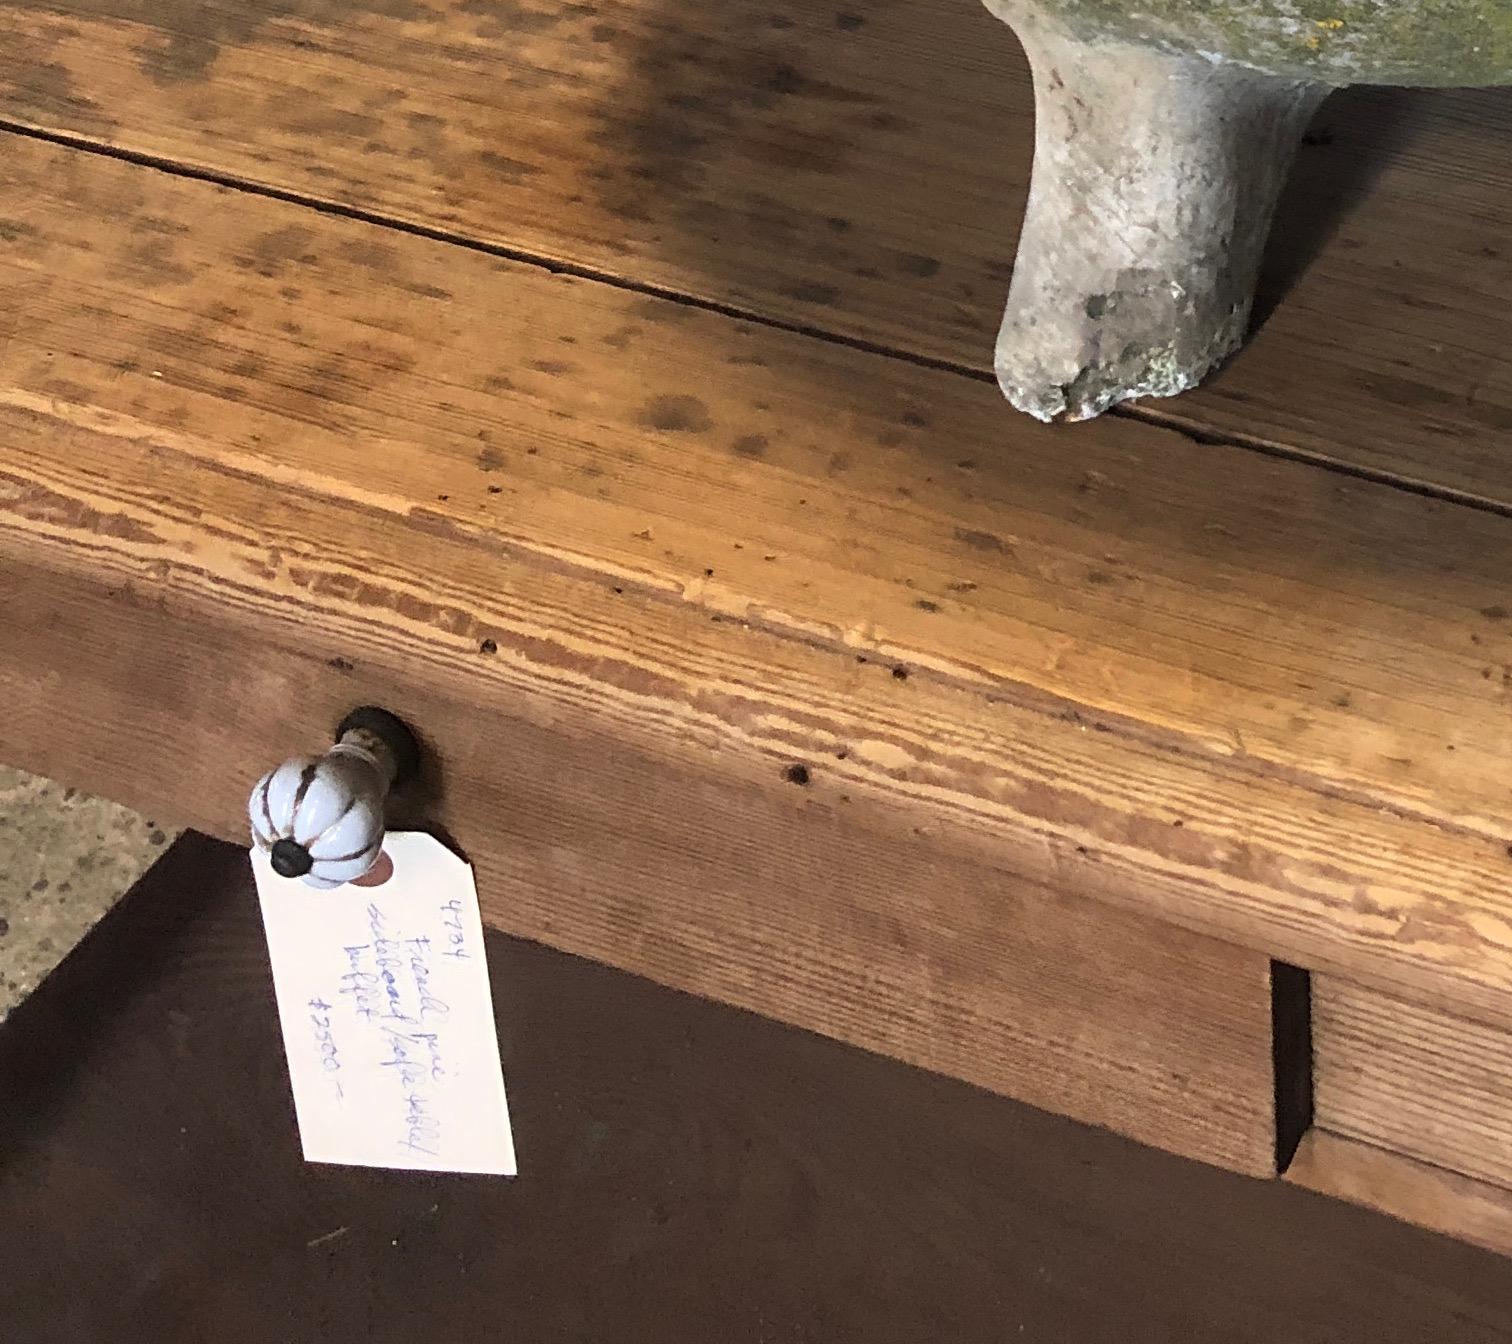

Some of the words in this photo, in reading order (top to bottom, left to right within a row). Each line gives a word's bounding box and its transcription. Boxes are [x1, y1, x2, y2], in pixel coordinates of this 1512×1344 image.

[440, 899, 471, 961] 4734
[338, 944, 378, 1023] buffet
[405, 934, 450, 1020] French
